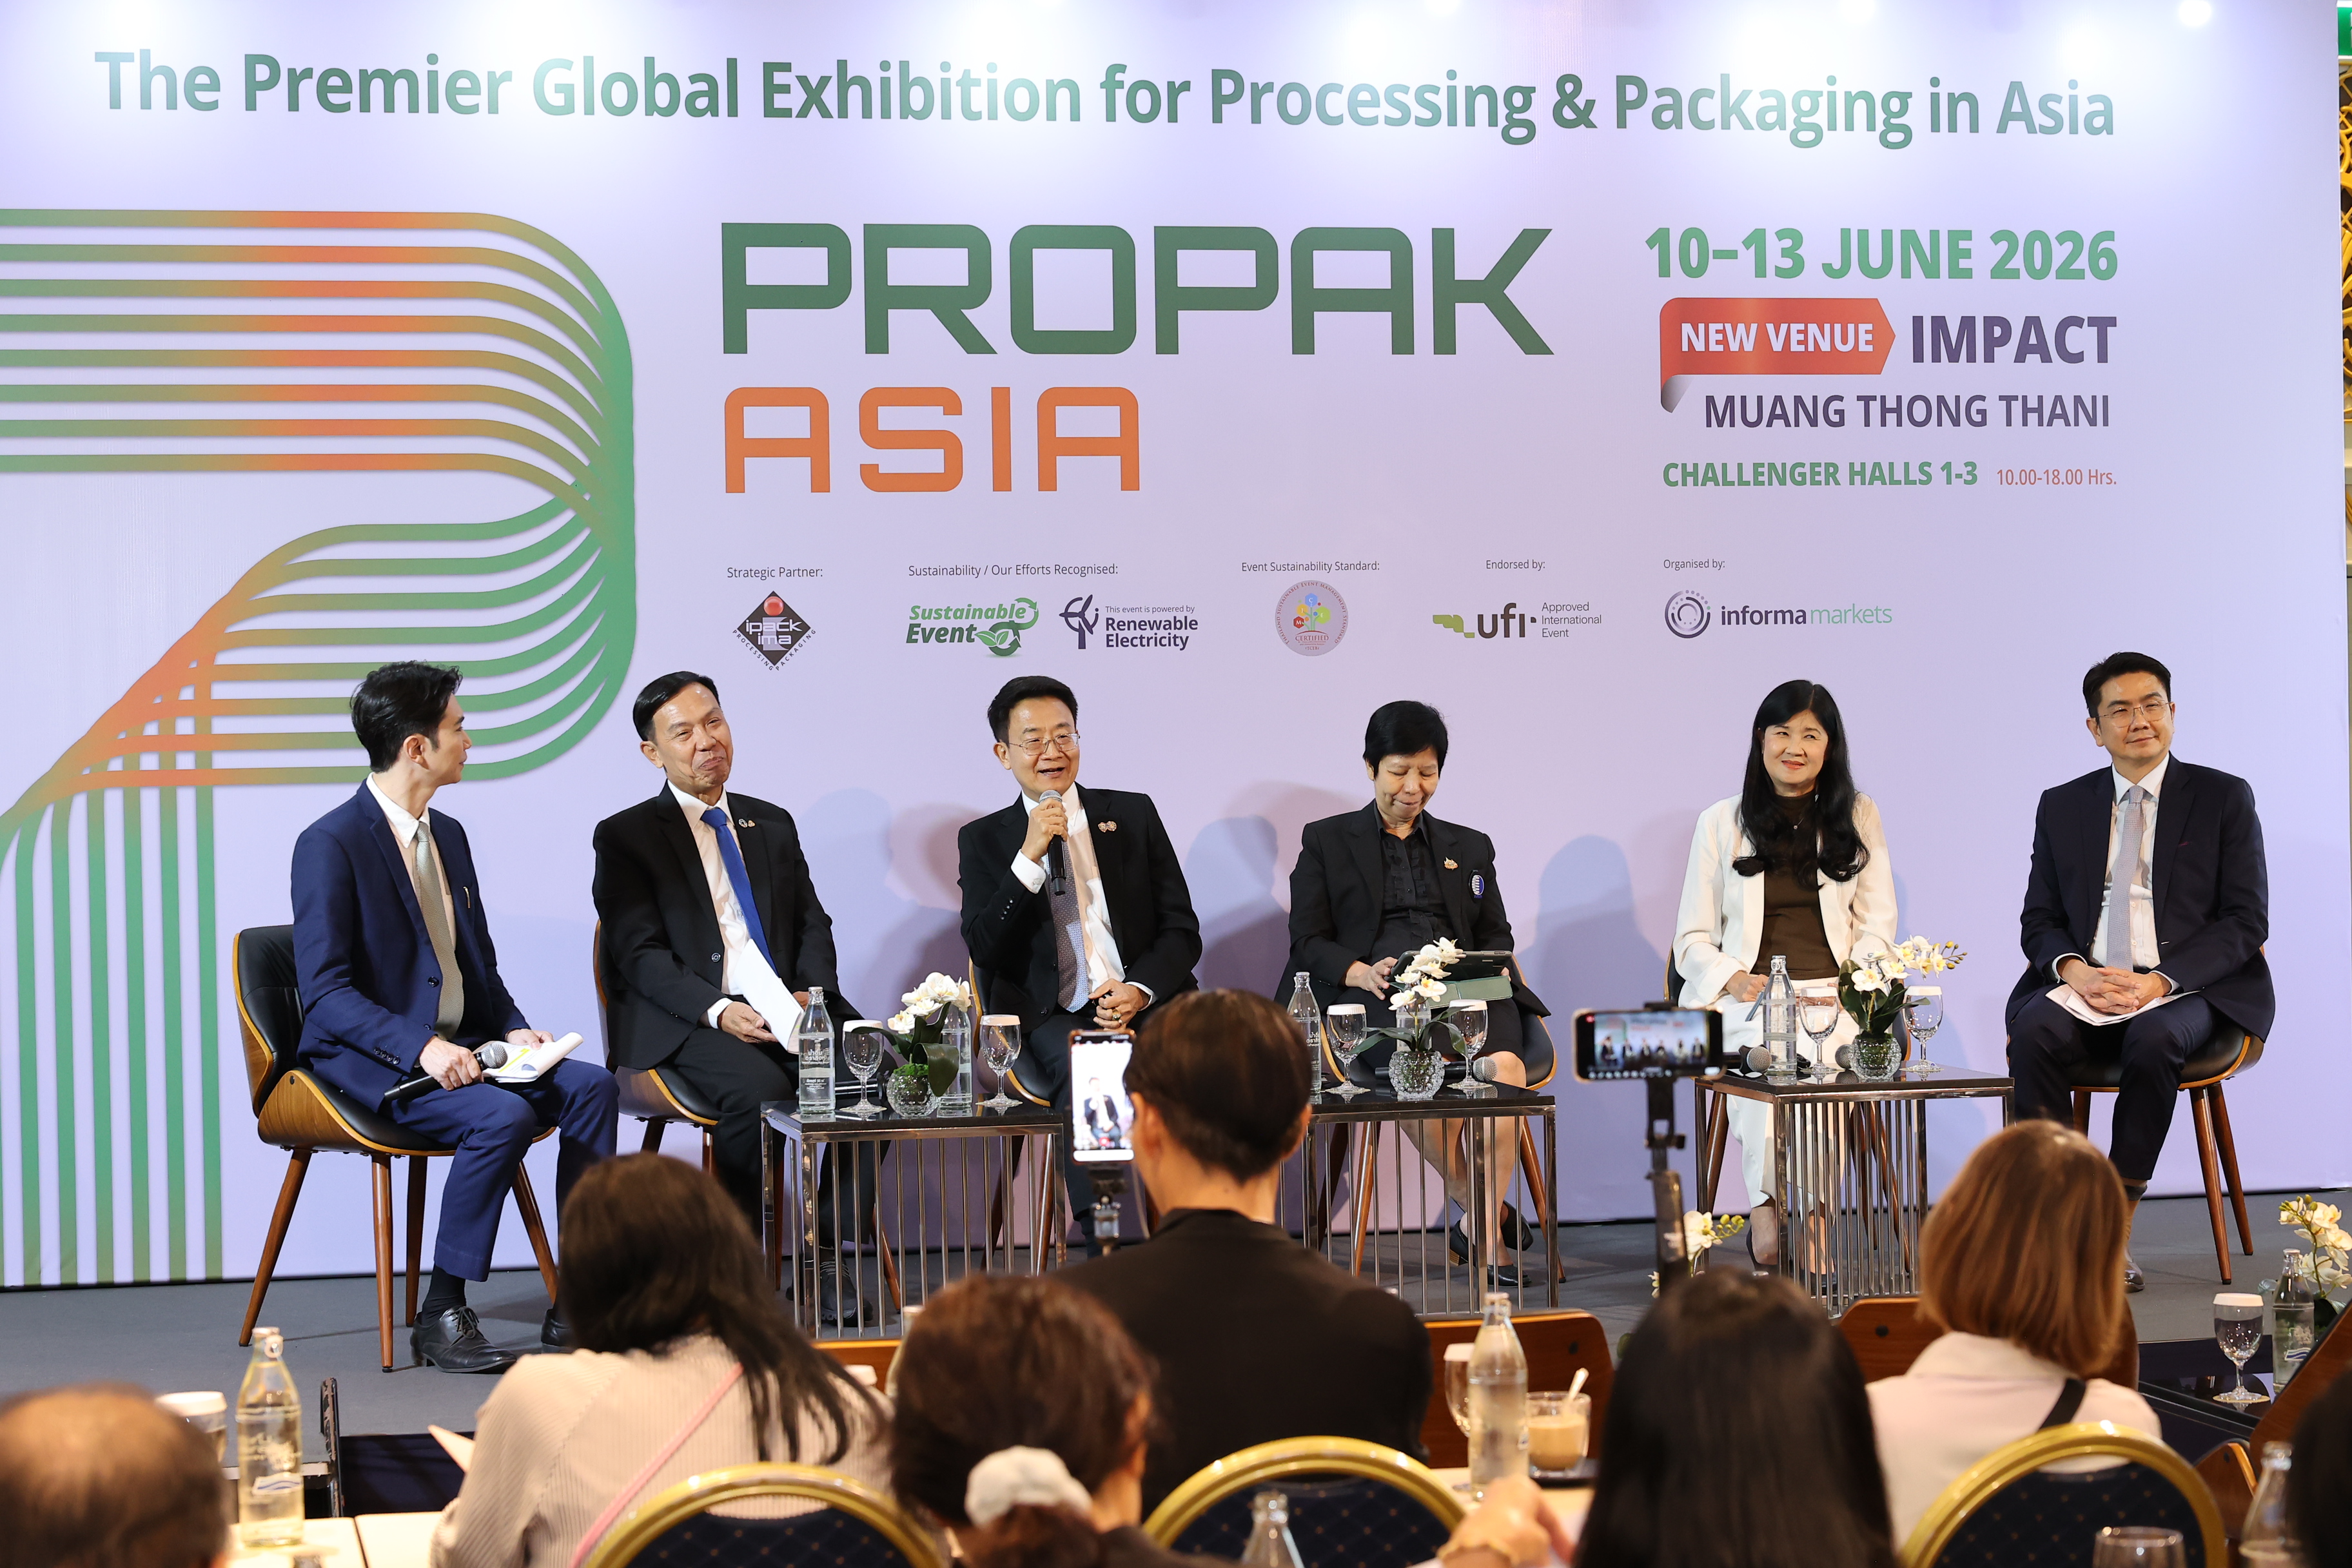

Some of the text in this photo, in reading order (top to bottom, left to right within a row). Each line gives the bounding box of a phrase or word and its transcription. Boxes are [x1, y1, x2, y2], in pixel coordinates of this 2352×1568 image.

[95, 50, 2113, 150] The Premier Global Exhibition for Processing & Packaging in Asia
[1822, 228, 1973, 279] JUNE
[1990, 230, 2117, 280] 2026
[721, 222, 1554, 355] PROPAK
[1681, 323, 1873, 352] NEW VENUE
[1912, 316, 2117, 364] IMPACT
[1706, 395, 2108, 427] MUANG THONG THANI
[725, 387, 1140, 493] ASIA
[1663, 462, 1977, 487] CHALLENGER HALLS 1-3
[1997, 469, 2116, 485] 10.00-18.00 Hrs.
[727, 567, 823, 580] Strategic Partner:
[909, 564, 1118, 578] Sustainability / Our Efforts Recognised:
[1242, 561, 1379, 573] Event Sustainability Standard:
[1486, 559, 1545, 571] Endorsed by:
[1663, 559, 1725, 571] Organised by:
[1152, 605, 1184, 614] powered
[1186, 605, 1195, 614] by
[1277, 585, 1300, 614] SUSTAINABLE
[1320, 583, 1346, 613] MANAGEMENT
[1542, 602, 1589, 614] Approved
[909, 603, 1026, 620] Sustainable
[1106, 616, 1198, 631] Renewable
[1542, 614, 1602, 624] International
[745, 618, 803, 645] ipack ima
[906, 623, 977, 643] Event
[1106, 632, 1189, 651] Electricity
[1277, 616, 1290, 645] THAILAND
[1334, 614, 1348, 644] STANDARD
[1542, 628, 1569, 638] Event
[732, 629, 774, 671] PROCESSING
[775, 629, 816, 671] PACKAGING
